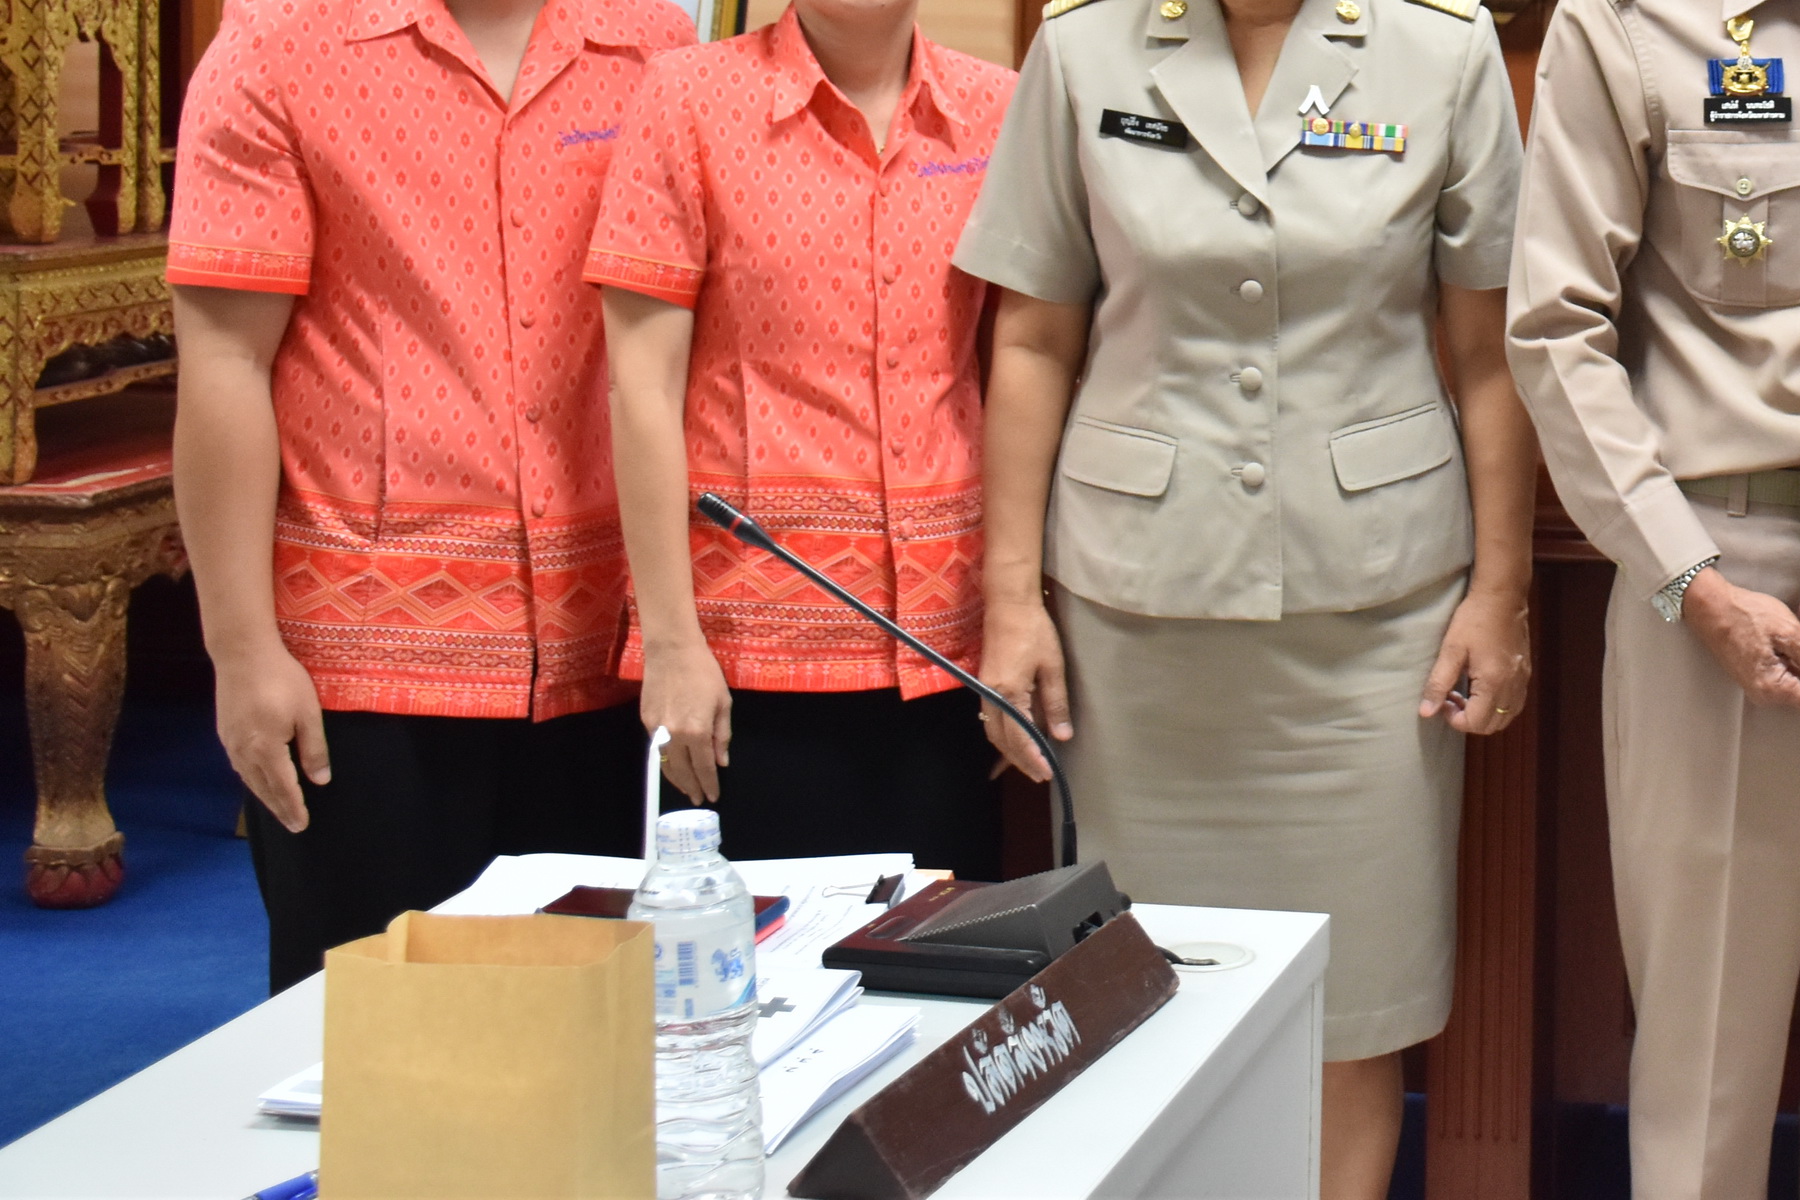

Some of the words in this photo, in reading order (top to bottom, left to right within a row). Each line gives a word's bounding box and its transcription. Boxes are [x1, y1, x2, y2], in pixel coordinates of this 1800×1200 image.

[961, 983, 1082, 1115] ปลัดจังหวัด
